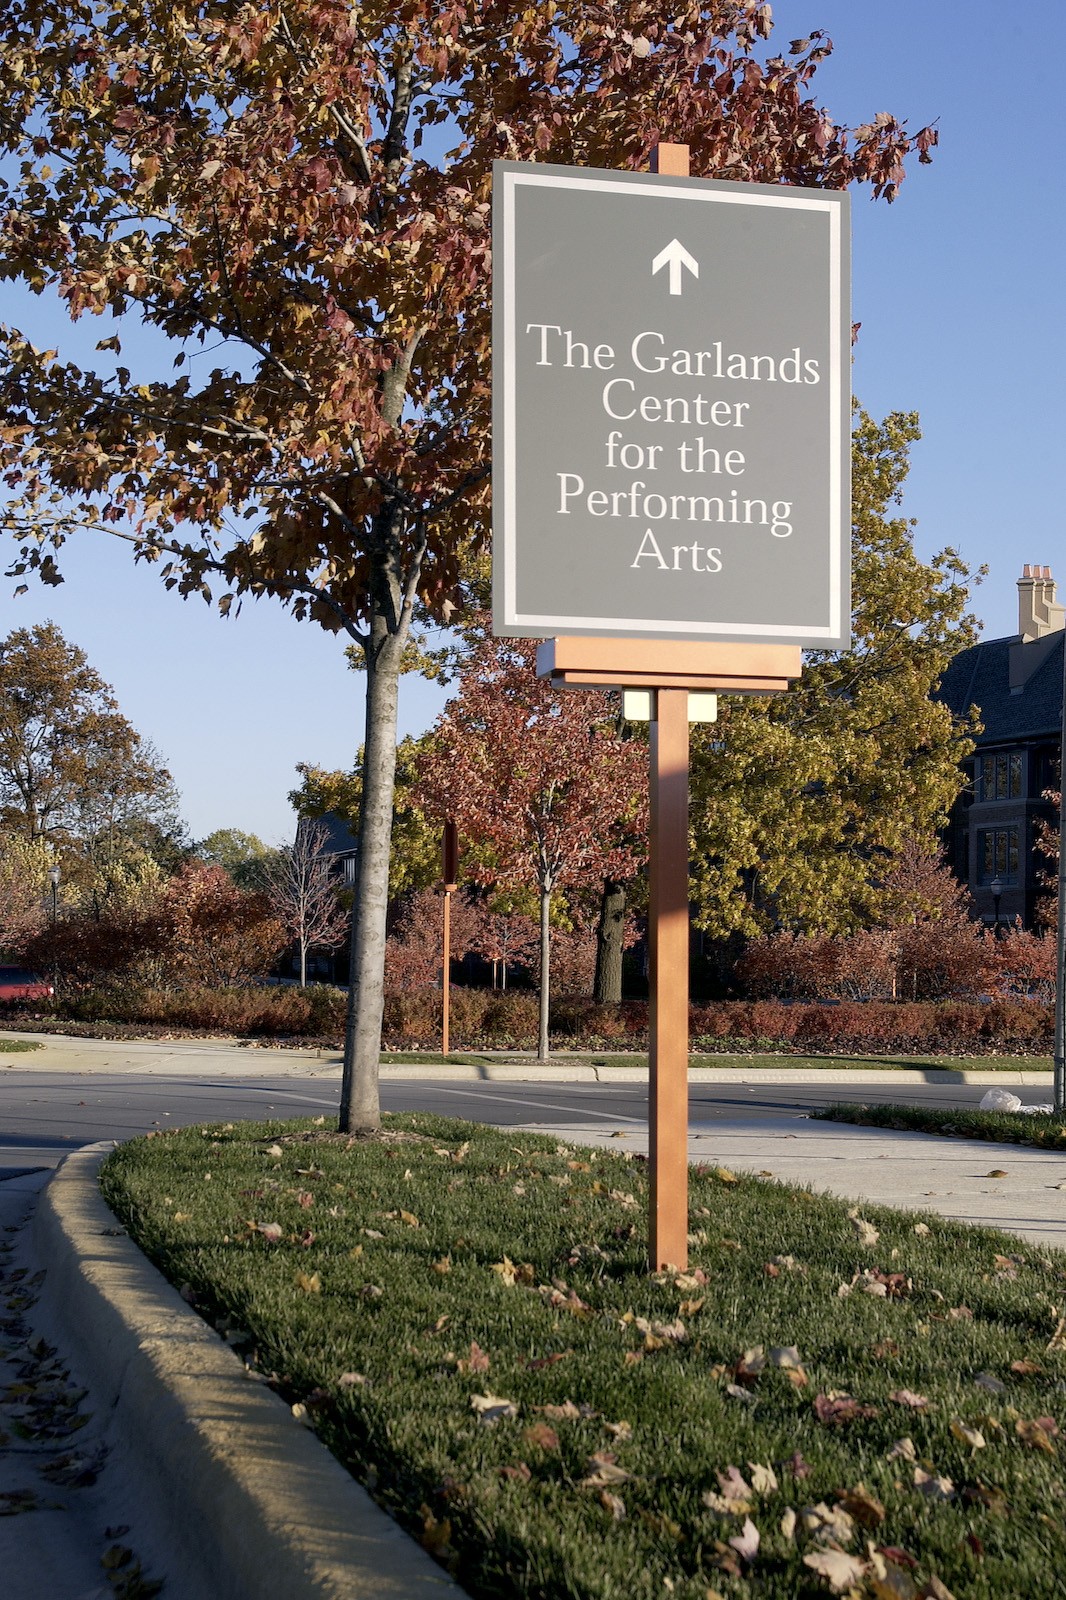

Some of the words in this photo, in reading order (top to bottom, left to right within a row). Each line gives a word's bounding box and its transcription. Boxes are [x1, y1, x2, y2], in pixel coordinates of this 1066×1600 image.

[525, 323, 615, 370] The
[631, 331, 821, 385] Garlands
[602, 378, 750, 428] Center
[604, 430, 664, 470] for
[677, 436, 746, 476] the
[556, 472, 794, 538] Performing
[629, 527, 723, 573] Arts
